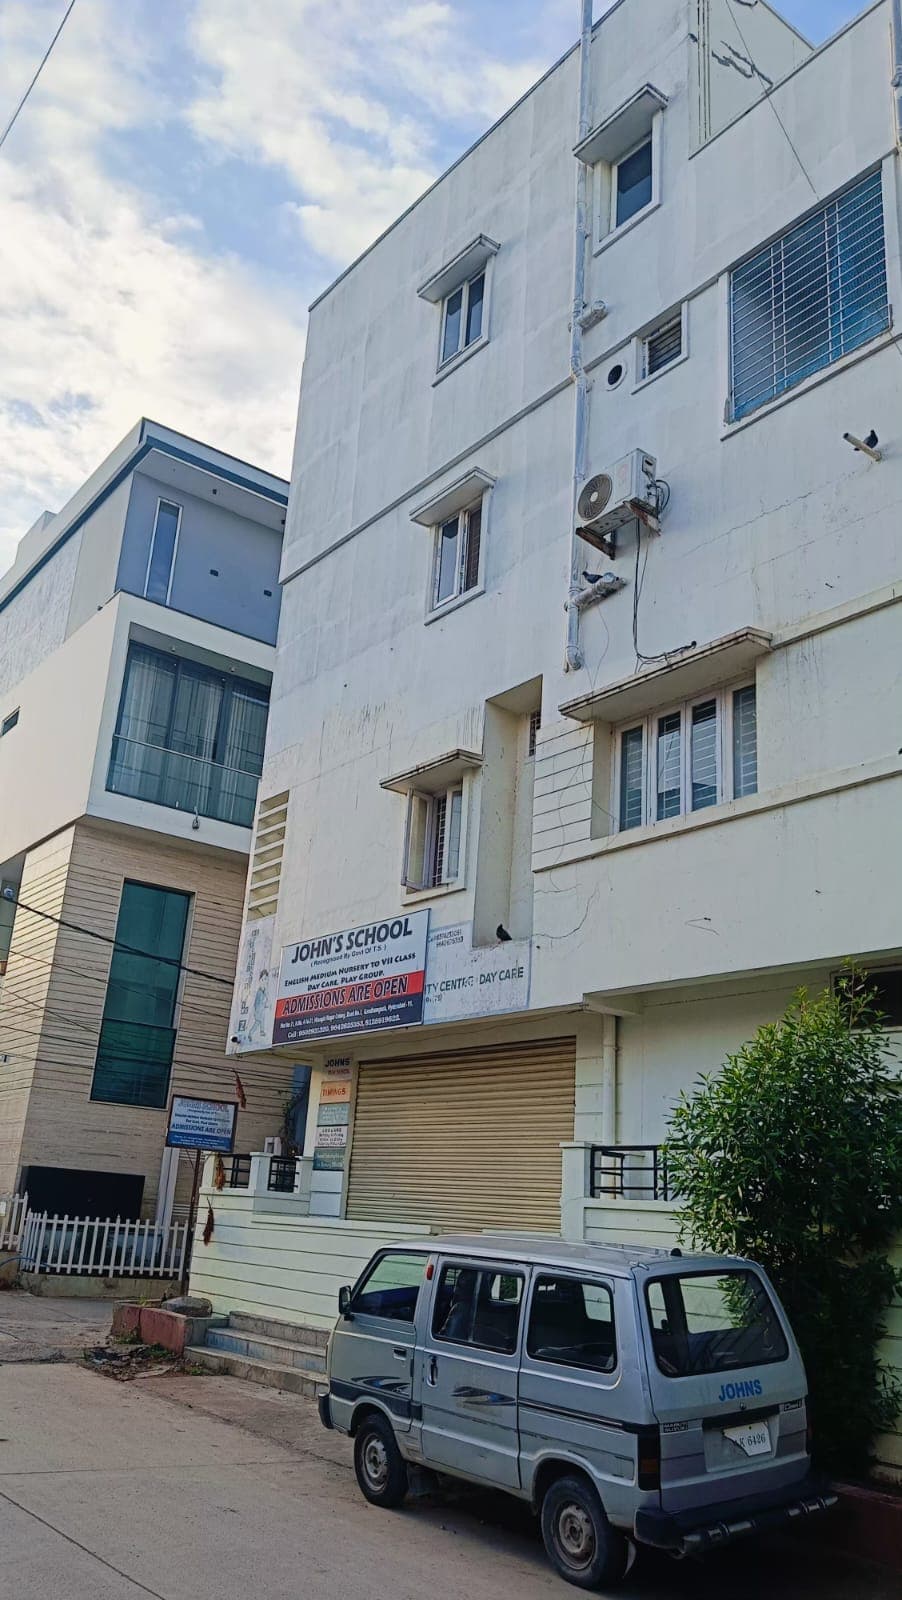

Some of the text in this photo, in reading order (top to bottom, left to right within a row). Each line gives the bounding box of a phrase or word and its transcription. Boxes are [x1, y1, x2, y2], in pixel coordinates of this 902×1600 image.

[291, 935, 344, 964] JOHN'S
[346, 918, 413, 950] SCHOOL
[284, 952, 417, 987] ENGLISH MEDIUM NURSERY TO VII CLASS
[479, 971, 498, 985] DAY
[498, 966, 524, 981] CARE
[307, 983, 321, 992] DAY
[341, 975, 358, 985] PLAY
[282, 974, 409, 1016] ADMISSIONS ARE OPEN
[324, 1057, 350, 1068] JOHNS
[718, 1379, 763, 1402] JOHNS
[747, 1433, 766, 1447] 6426
